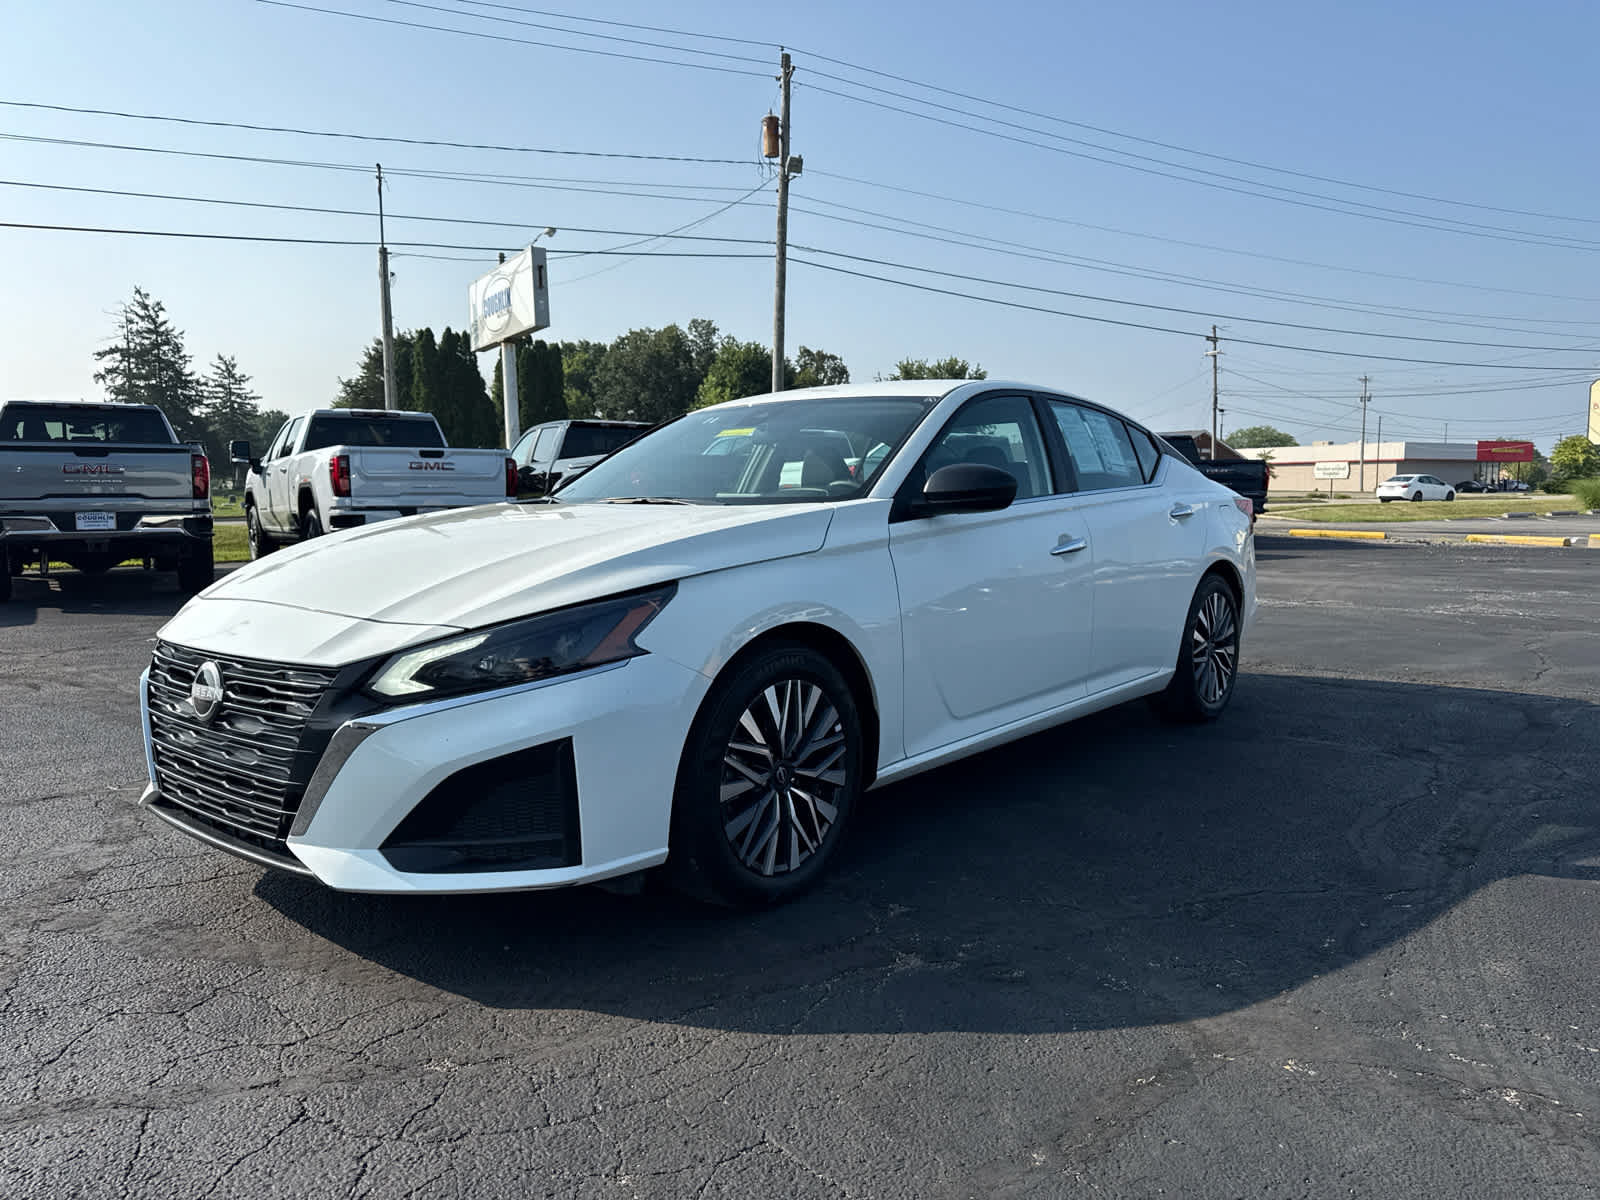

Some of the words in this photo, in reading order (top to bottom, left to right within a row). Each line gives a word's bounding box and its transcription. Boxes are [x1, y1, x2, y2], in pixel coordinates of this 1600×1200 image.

[62, 463, 126, 474] GMC
[408, 461, 456, 471] GMC
[192, 684, 223, 701] SSAN
